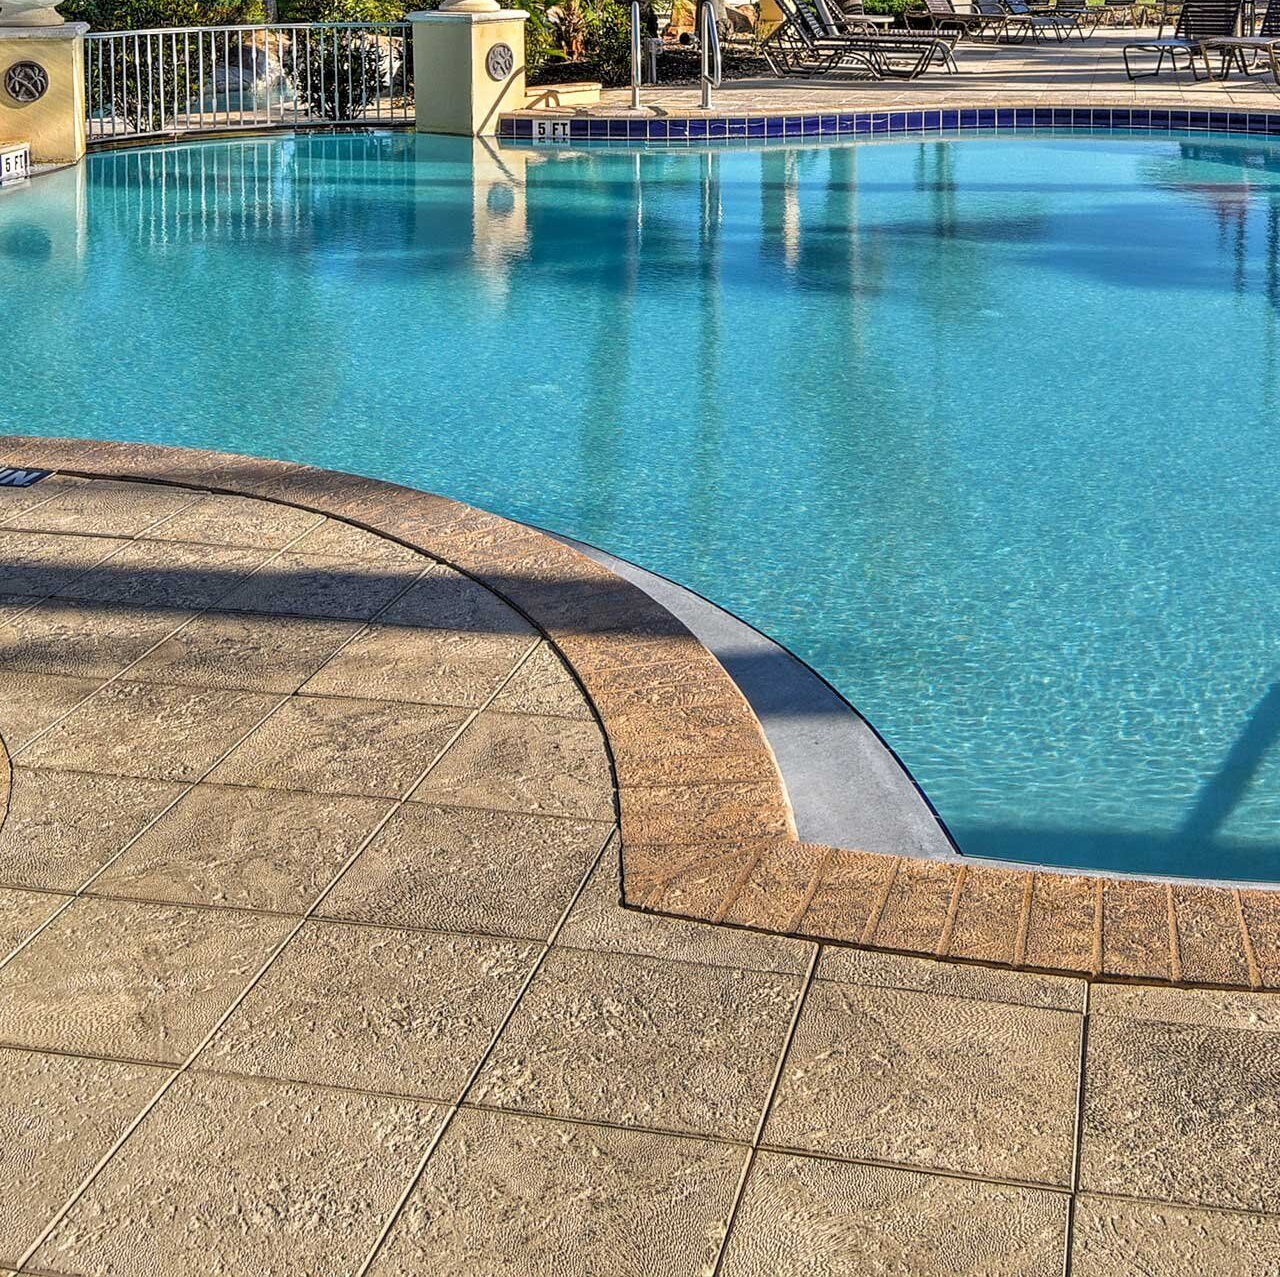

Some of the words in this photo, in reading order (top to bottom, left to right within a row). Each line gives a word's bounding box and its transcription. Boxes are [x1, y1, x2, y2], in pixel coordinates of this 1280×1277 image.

[538, 122, 546, 136] 5
[552, 122, 568, 136] FT.
[5, 157, 11, 172] 5
